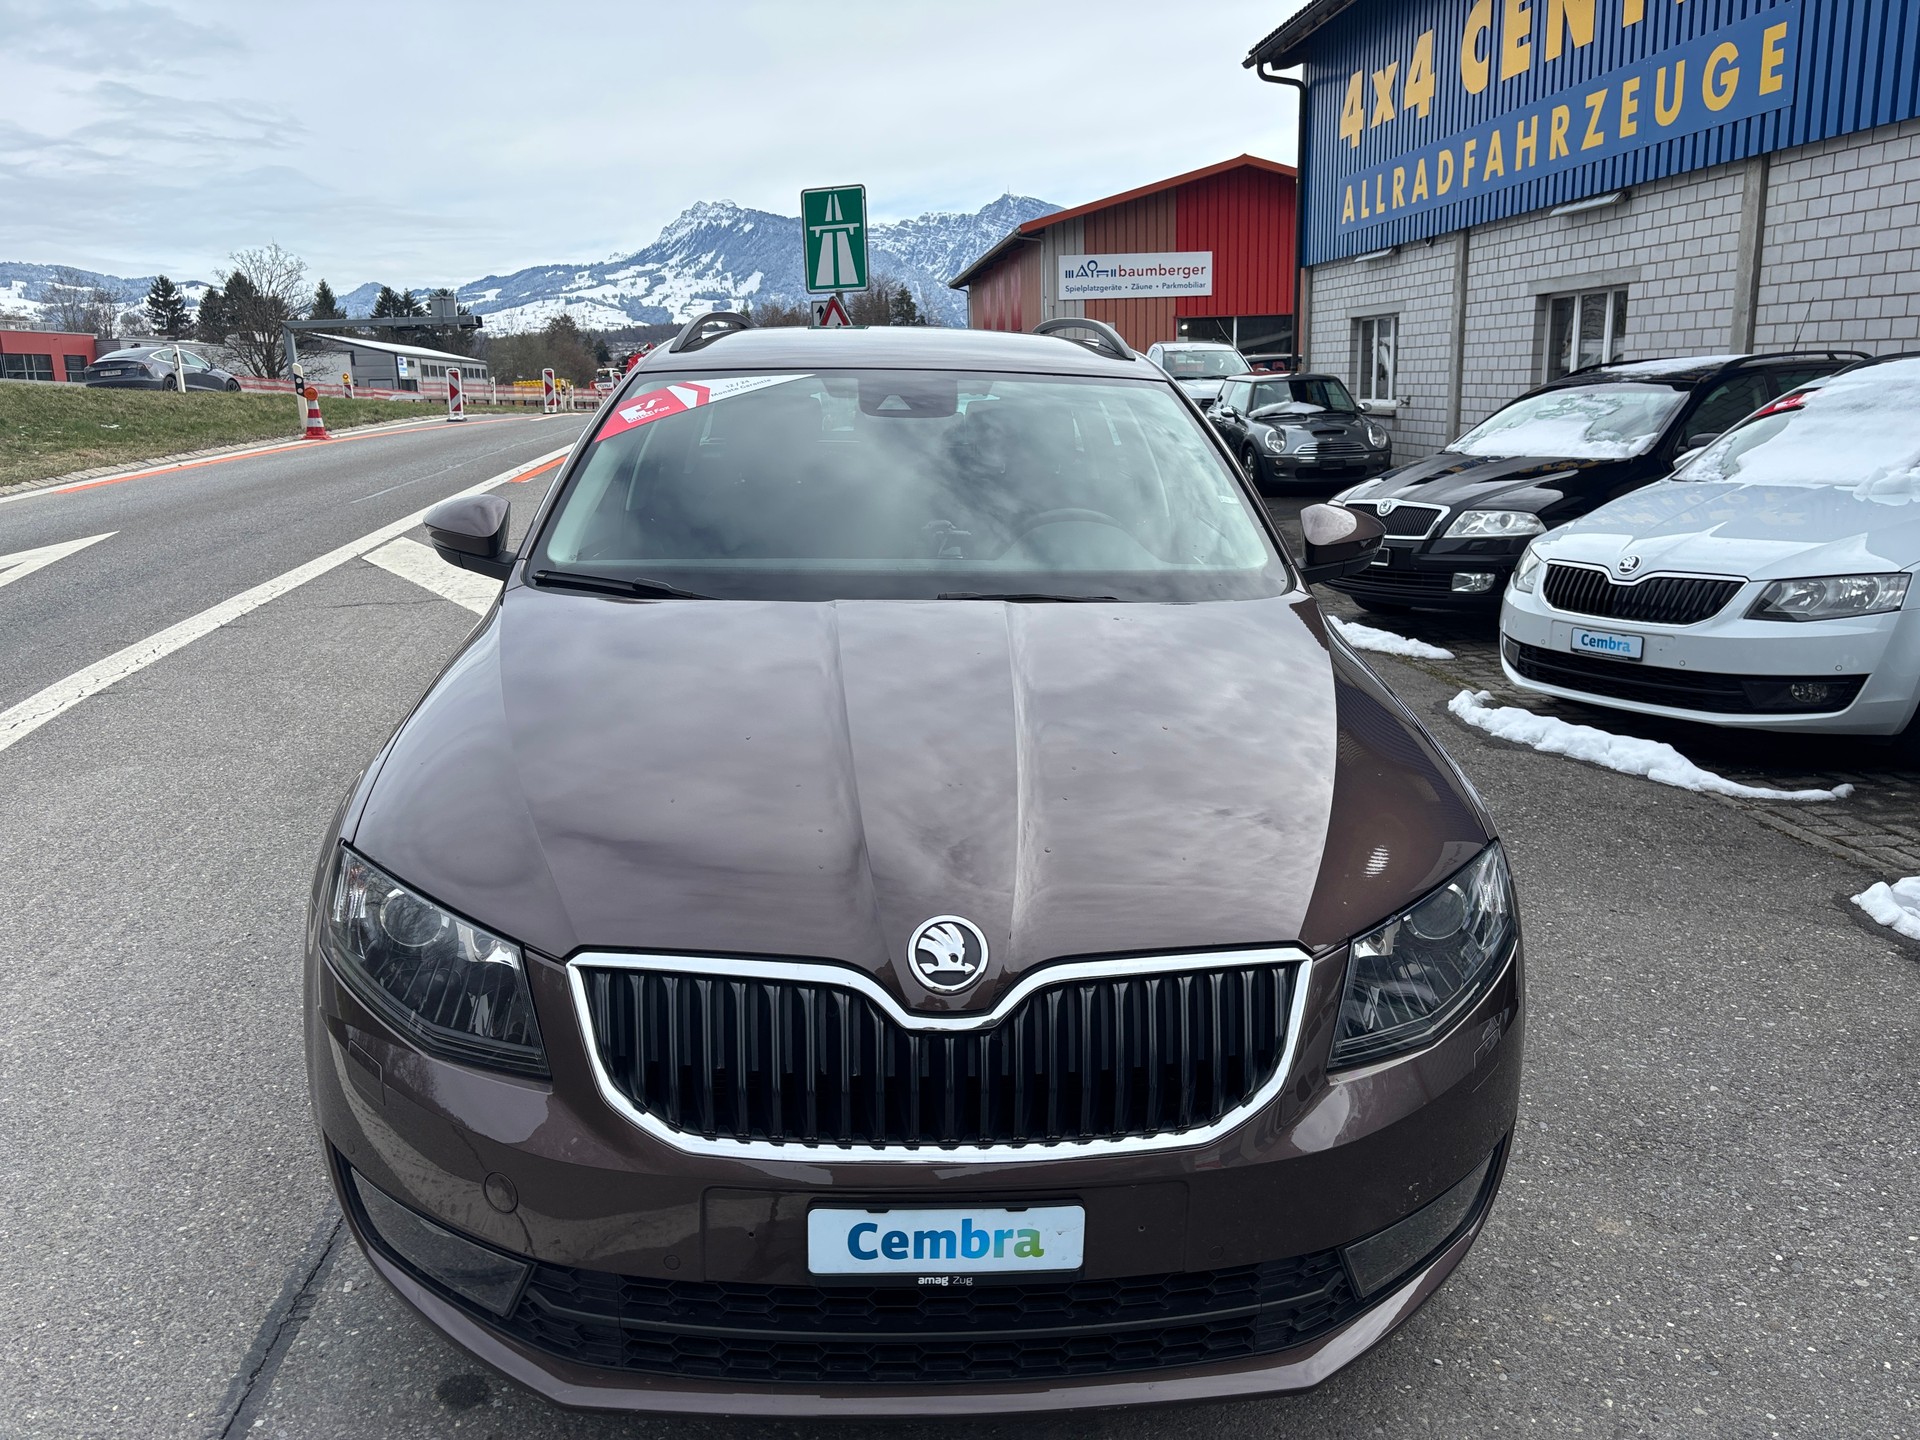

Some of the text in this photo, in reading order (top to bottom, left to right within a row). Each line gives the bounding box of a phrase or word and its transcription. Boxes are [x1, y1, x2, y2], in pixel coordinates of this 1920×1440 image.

[1341, 21, 1788, 225] ALLRADFAHRZEUGE
[1118, 264, 1207, 279] baumberger
[1065, 282, 1206, 293] Spielplatzgeräte Zäune Parkmobiliar
[740, 379, 771, 389] Garantie
[1581, 633, 1631, 652] Cembra
[847, 1218, 1044, 1261] Cembra
[918, 1276, 973, 1286] amag Zug
